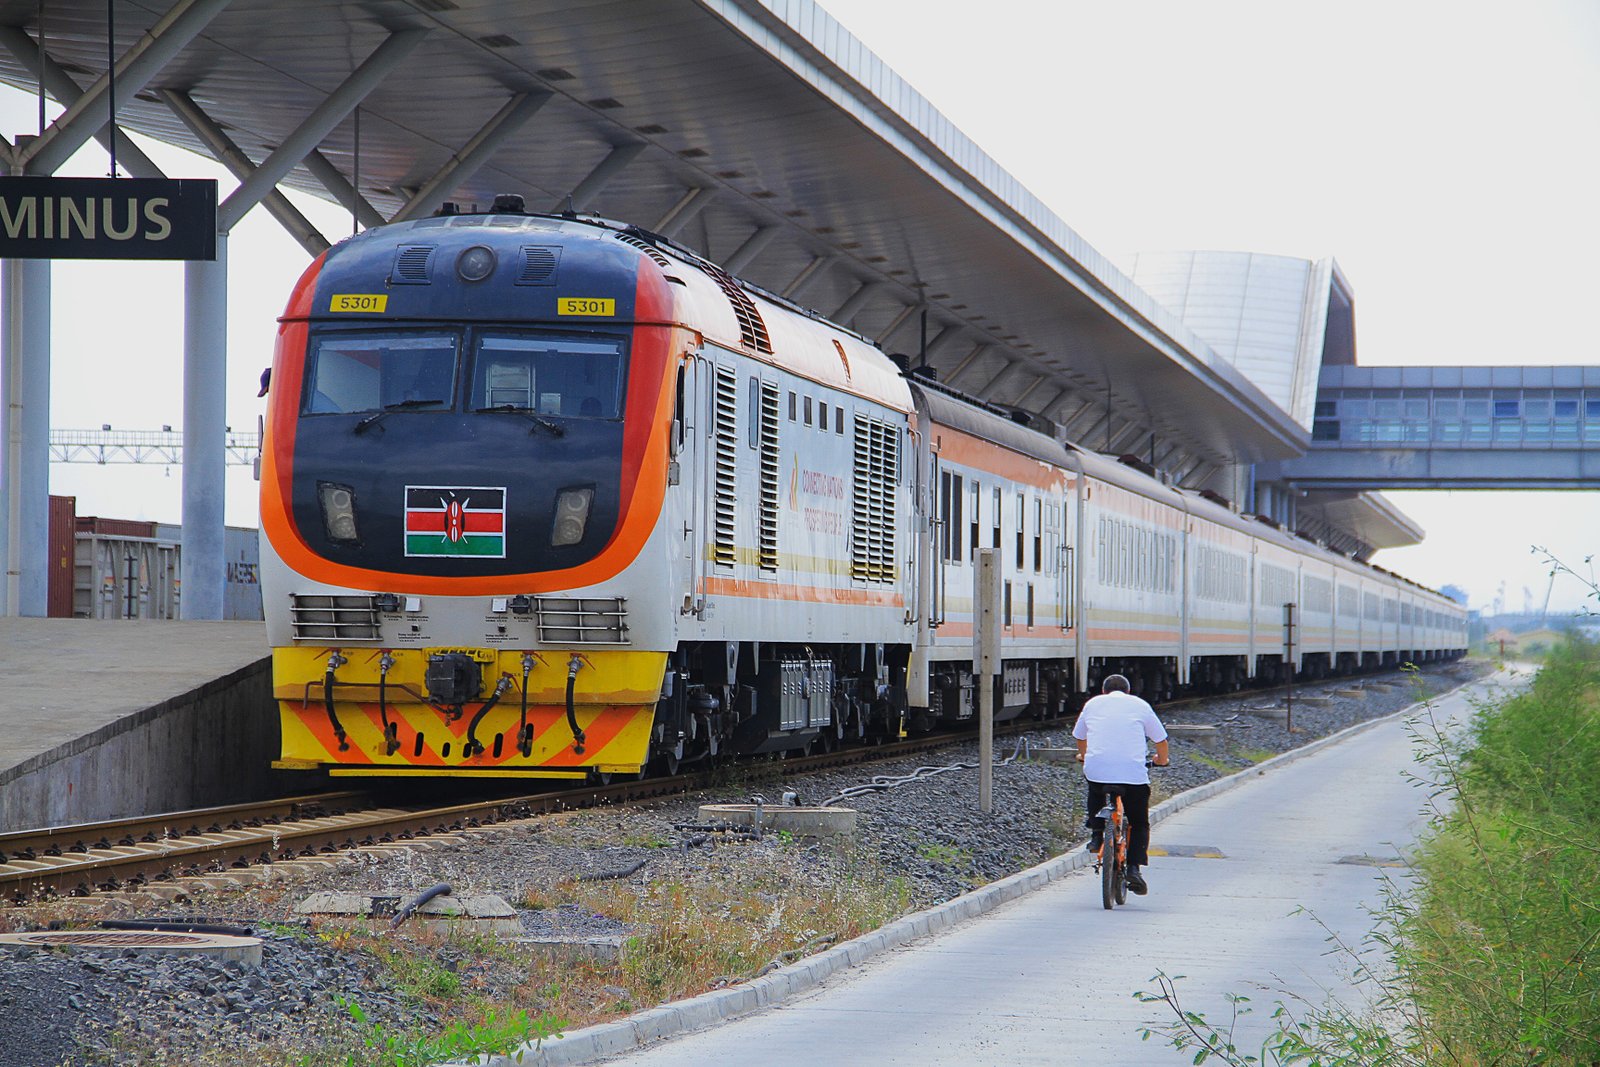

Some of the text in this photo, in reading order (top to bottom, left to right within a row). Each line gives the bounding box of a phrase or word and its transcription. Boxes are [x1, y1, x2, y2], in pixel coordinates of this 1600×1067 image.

[0, 196, 172, 241] MINUS
[340, 297, 378, 309] 5301
[567, 300, 605, 313] 5301
